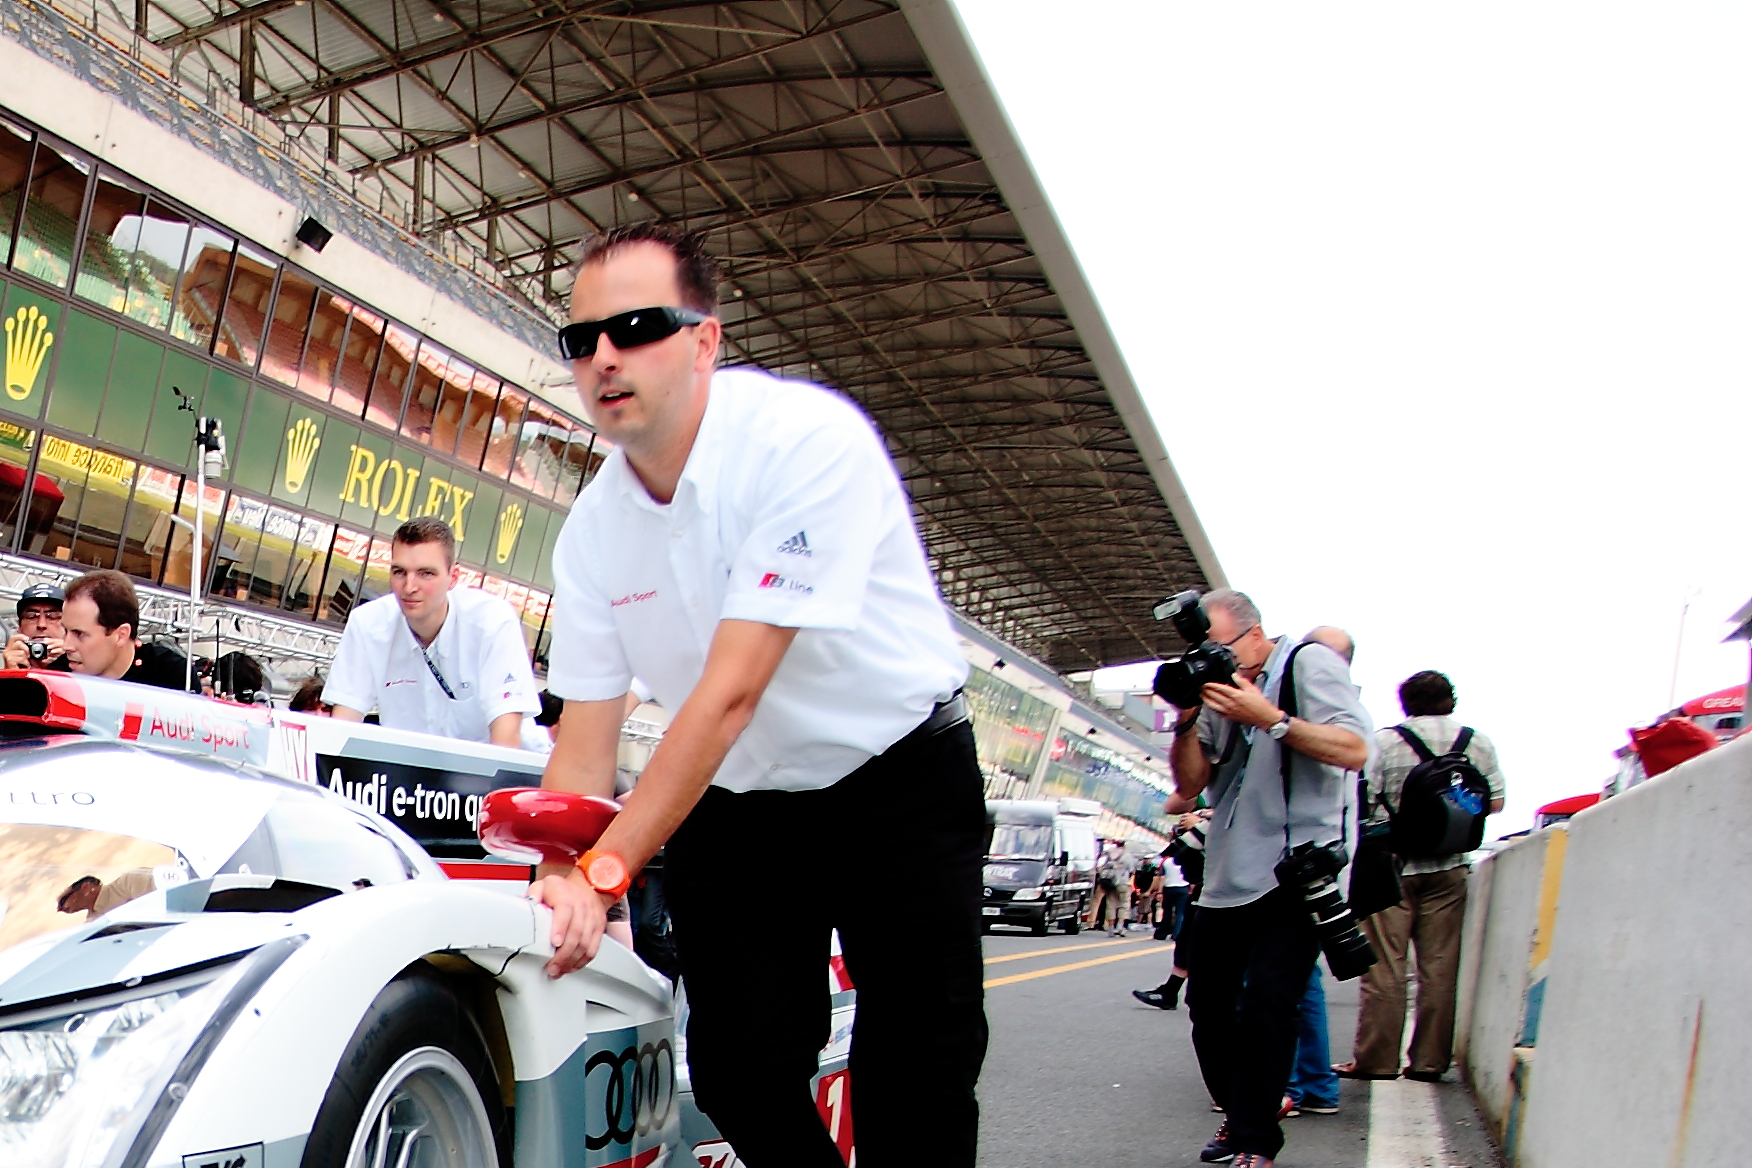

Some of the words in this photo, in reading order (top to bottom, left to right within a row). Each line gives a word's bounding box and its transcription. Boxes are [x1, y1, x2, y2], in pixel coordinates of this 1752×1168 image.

[339, 444, 474, 542] ROLEX
[150, 707, 195, 742] Audi
[200, 715, 251, 753] Sport
[328, 767, 388, 815] Audi
[392, 783, 460, 821] e-tron
